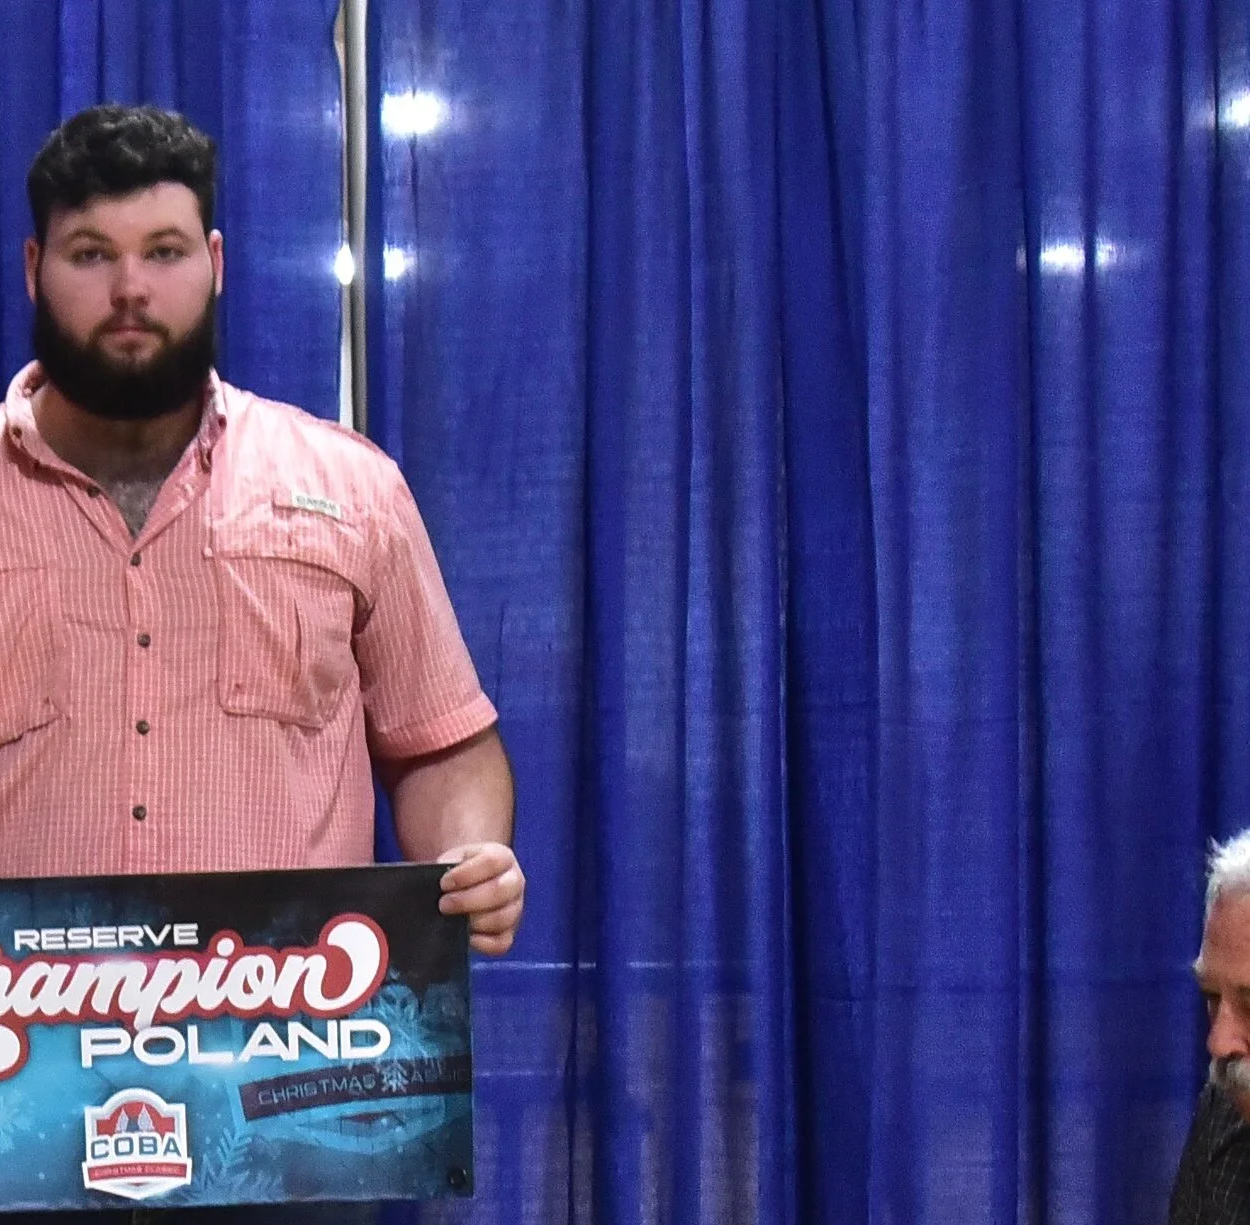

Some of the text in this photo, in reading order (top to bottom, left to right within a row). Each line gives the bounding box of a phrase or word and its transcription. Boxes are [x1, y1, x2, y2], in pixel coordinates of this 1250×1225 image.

[13, 922, 199, 952] RESERVE
[80, 1019, 392, 1069] POLAND
[90, 1136, 182, 1160] COBA
